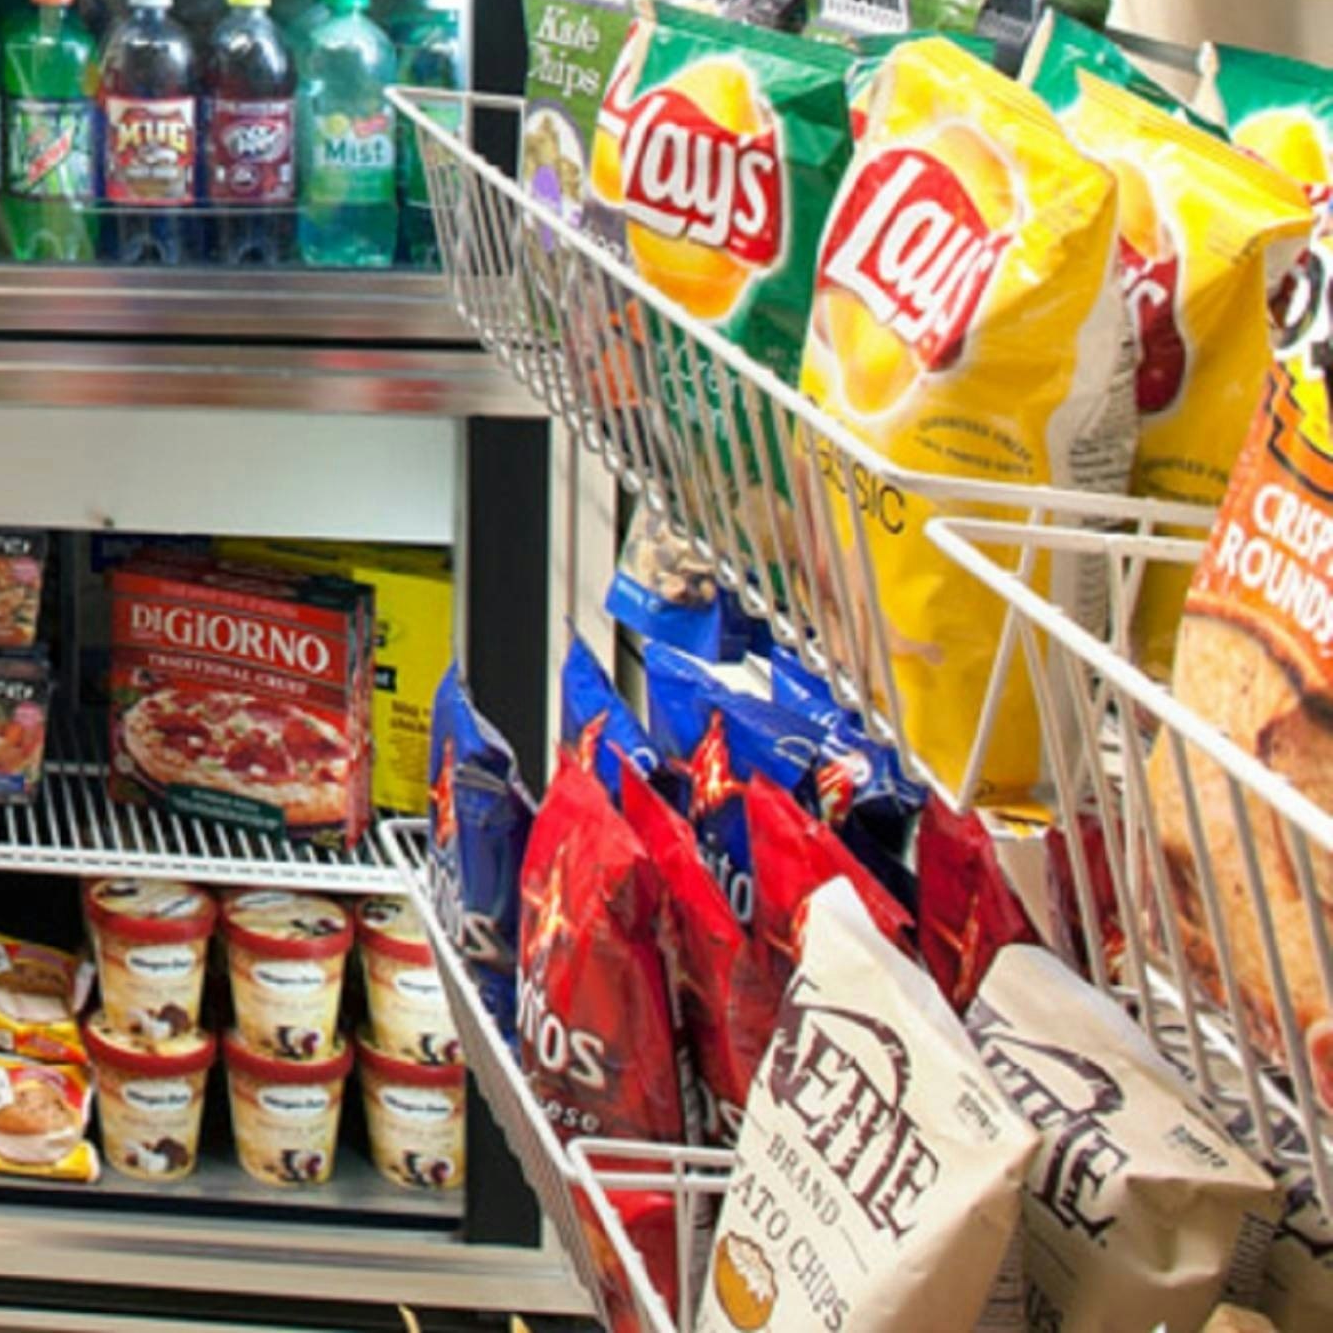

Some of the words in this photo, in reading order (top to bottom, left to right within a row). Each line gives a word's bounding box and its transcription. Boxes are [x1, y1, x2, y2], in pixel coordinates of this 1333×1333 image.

[536, 4, 601, 52] Kale
[116, 122, 187, 154] MUG
[613, 90, 773, 248] Lay's
[826, 152, 1010, 348] Lay's
[1252, 482, 1333, 574] CRISP
[146, 651, 250, 684] TRADITIONAL
[253, 670, 308, 697] CRUST
[766, 1134, 842, 1227] BRAND
[787, 1236, 850, 1333] CHIPS
